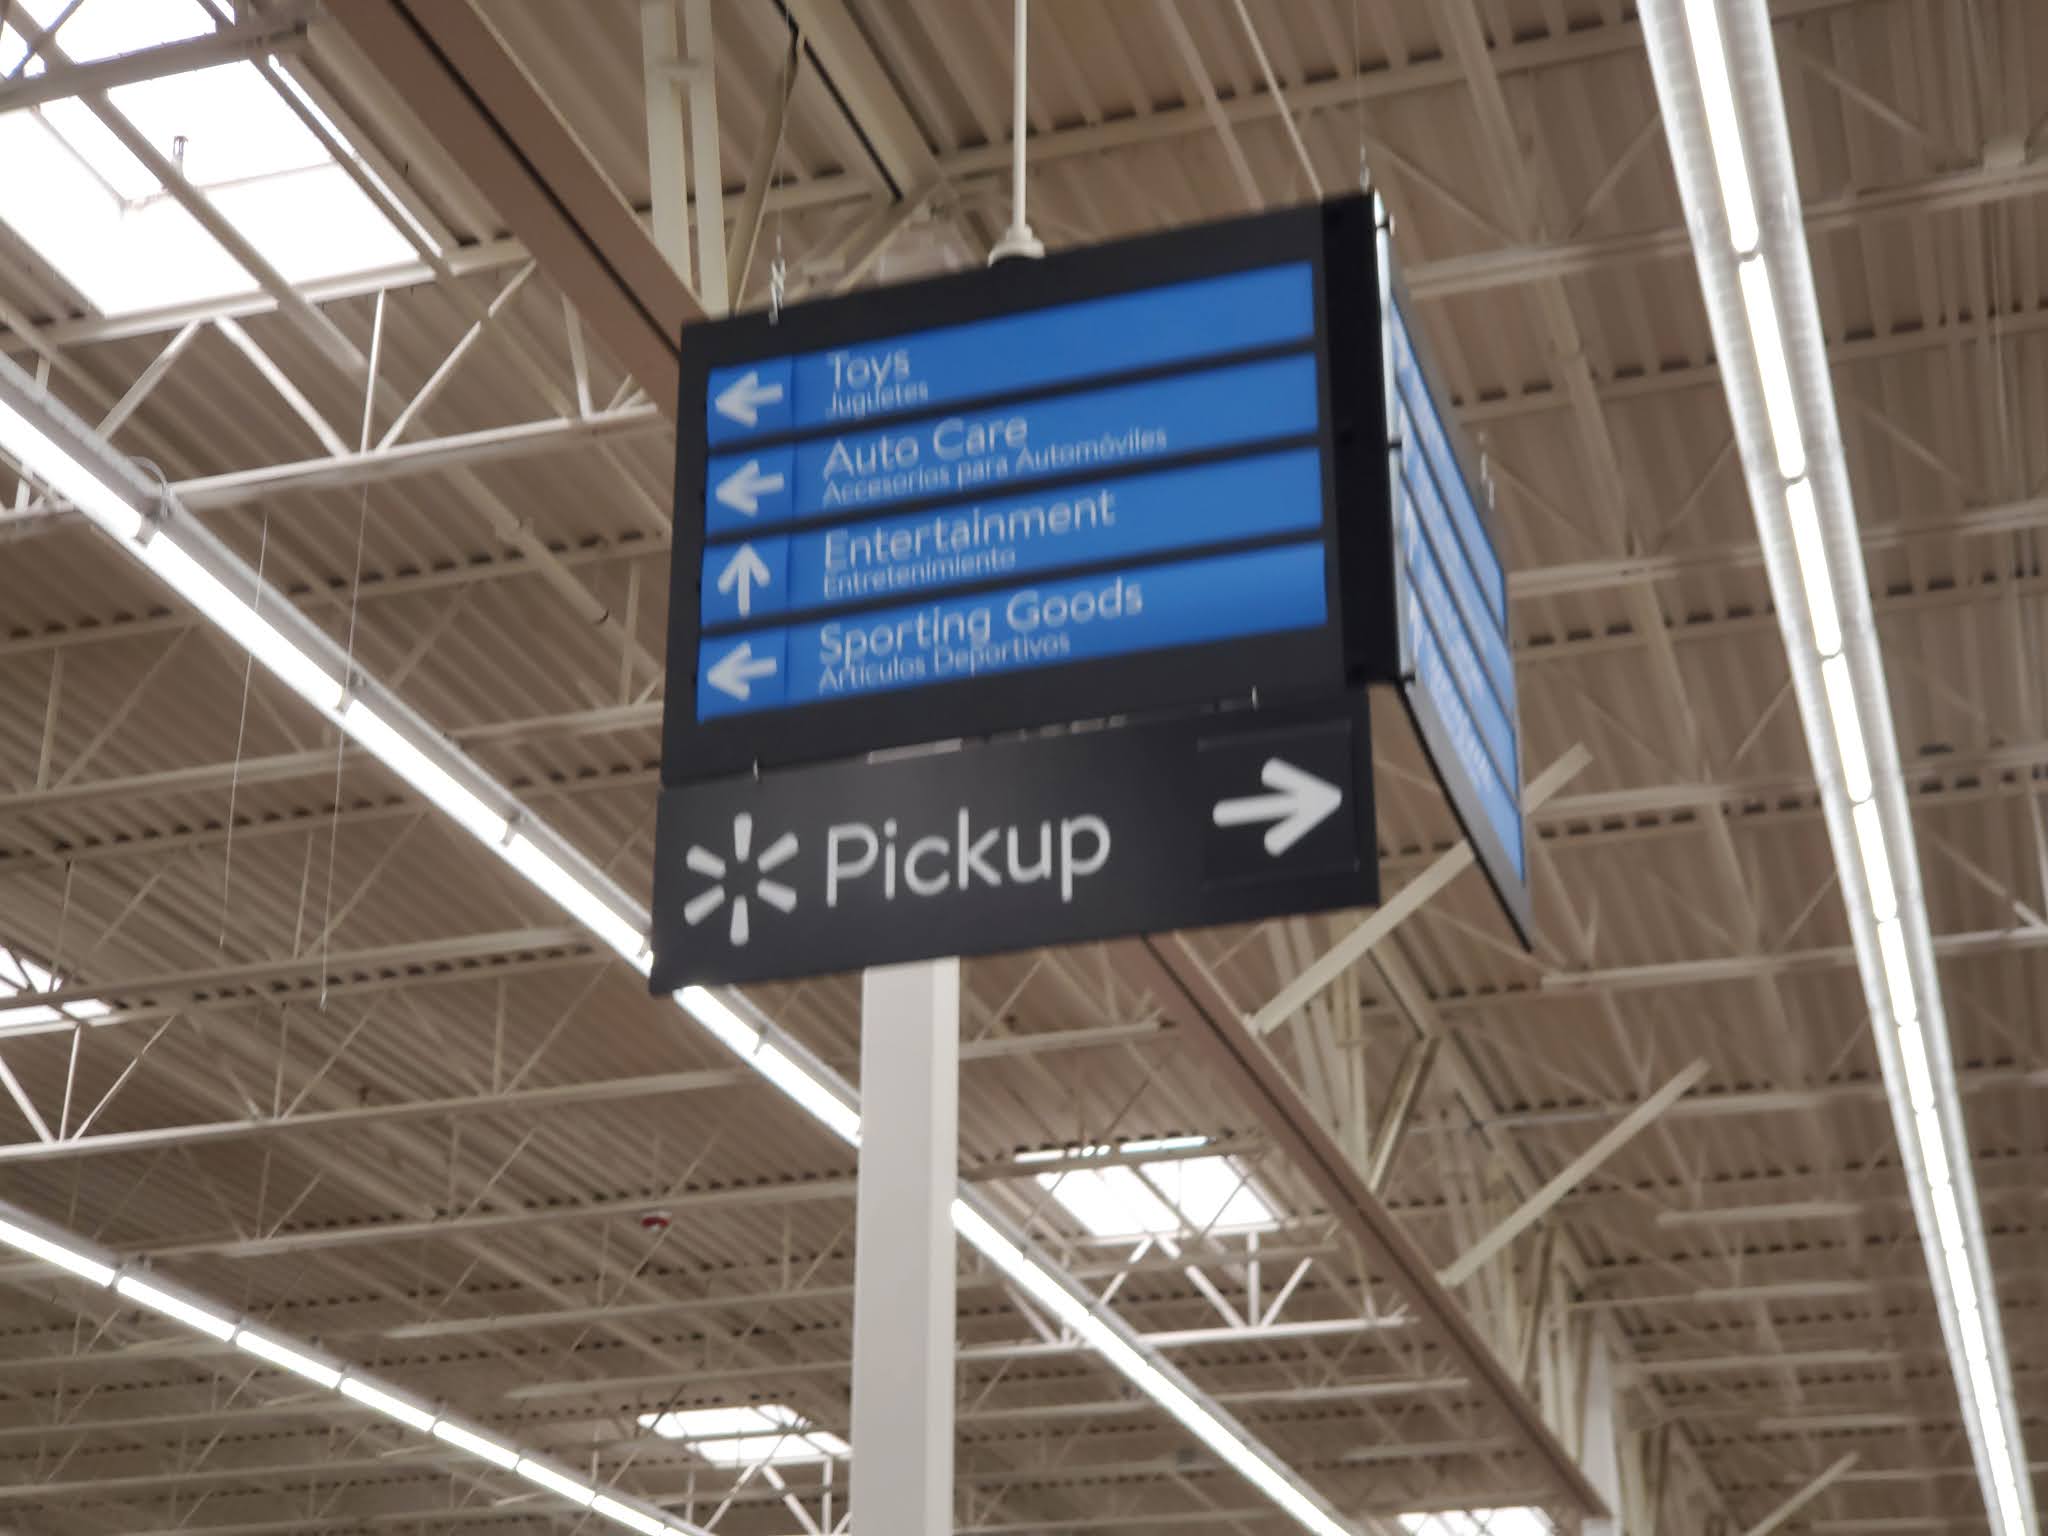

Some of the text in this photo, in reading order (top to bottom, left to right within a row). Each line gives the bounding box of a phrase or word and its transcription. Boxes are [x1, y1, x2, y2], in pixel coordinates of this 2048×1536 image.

[827, 349, 910, 390] Toys
[823, 416, 1028, 480] Auto Care
[957, 456, 1008, 490] para
[1016, 426, 1167, 474] Automóviles
[825, 489, 1116, 571] Entertainment
[819, 576, 1143, 669] Sporting Goods
[826, 808, 1112, 906] Pickup
